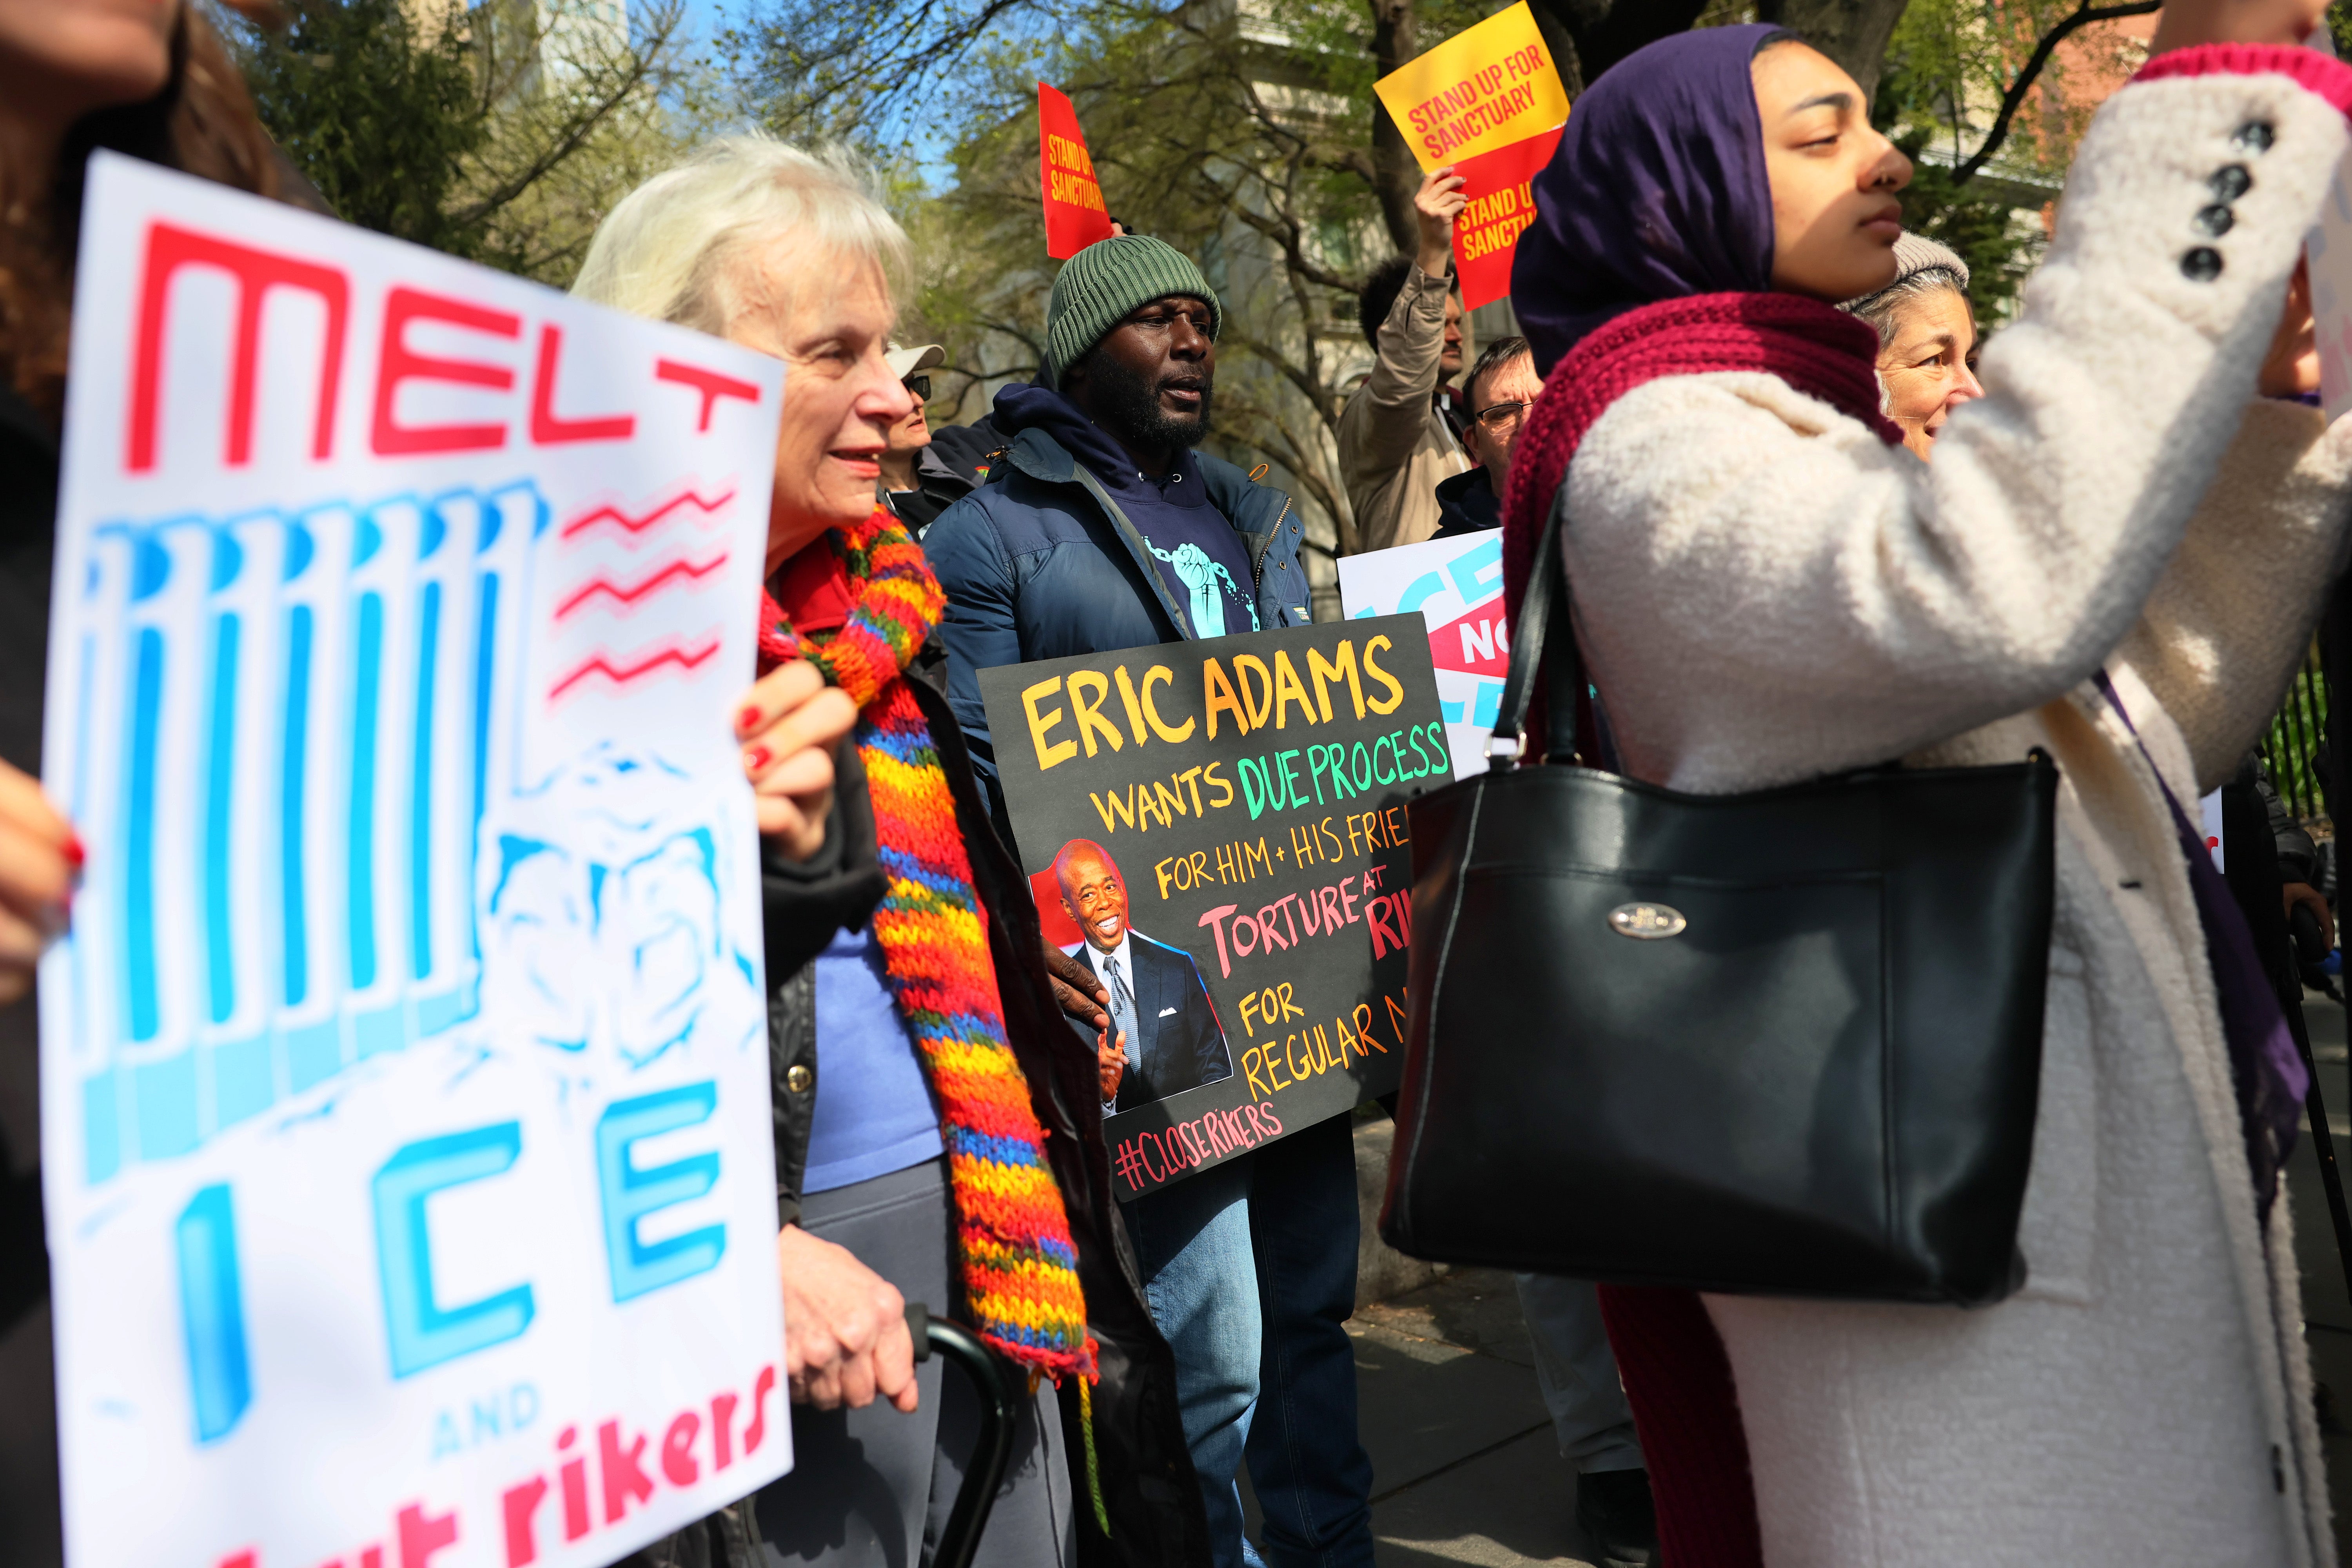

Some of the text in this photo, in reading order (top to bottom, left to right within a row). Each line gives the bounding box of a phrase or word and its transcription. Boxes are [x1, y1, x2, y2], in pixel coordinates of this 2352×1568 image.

[1408, 44, 1545, 133] STAND UP FOR
[1423, 81, 1535, 159] SANCTUARY
[1048, 133, 1081, 172] STAND
[1458, 180, 1534, 232] STAND U
[1462, 209, 1537, 261] SANCT
[122, 218, 763, 476] MELT
[1021, 634, 1405, 771] ERIC ADAMS
[1089, 721, 1449, 834] WANTS DUE PROCESS
[1154, 850, 1215, 900] FOR
[1215, 836, 1274, 885] HIM
[1290, 817, 1343, 869] HIS
[1346, 804, 1410, 857] FRIE
[1198, 877, 1361, 979] TORTURE
[1363, 864, 1387, 896] AT
[1238, 982, 1305, 1038] FOR
[1240, 986, 1408, 1103] REGULAR N
[175, 1079, 727, 1449] ICE
[430, 1381, 543, 1461] AND
[501, 1363, 777, 1568] rikers
